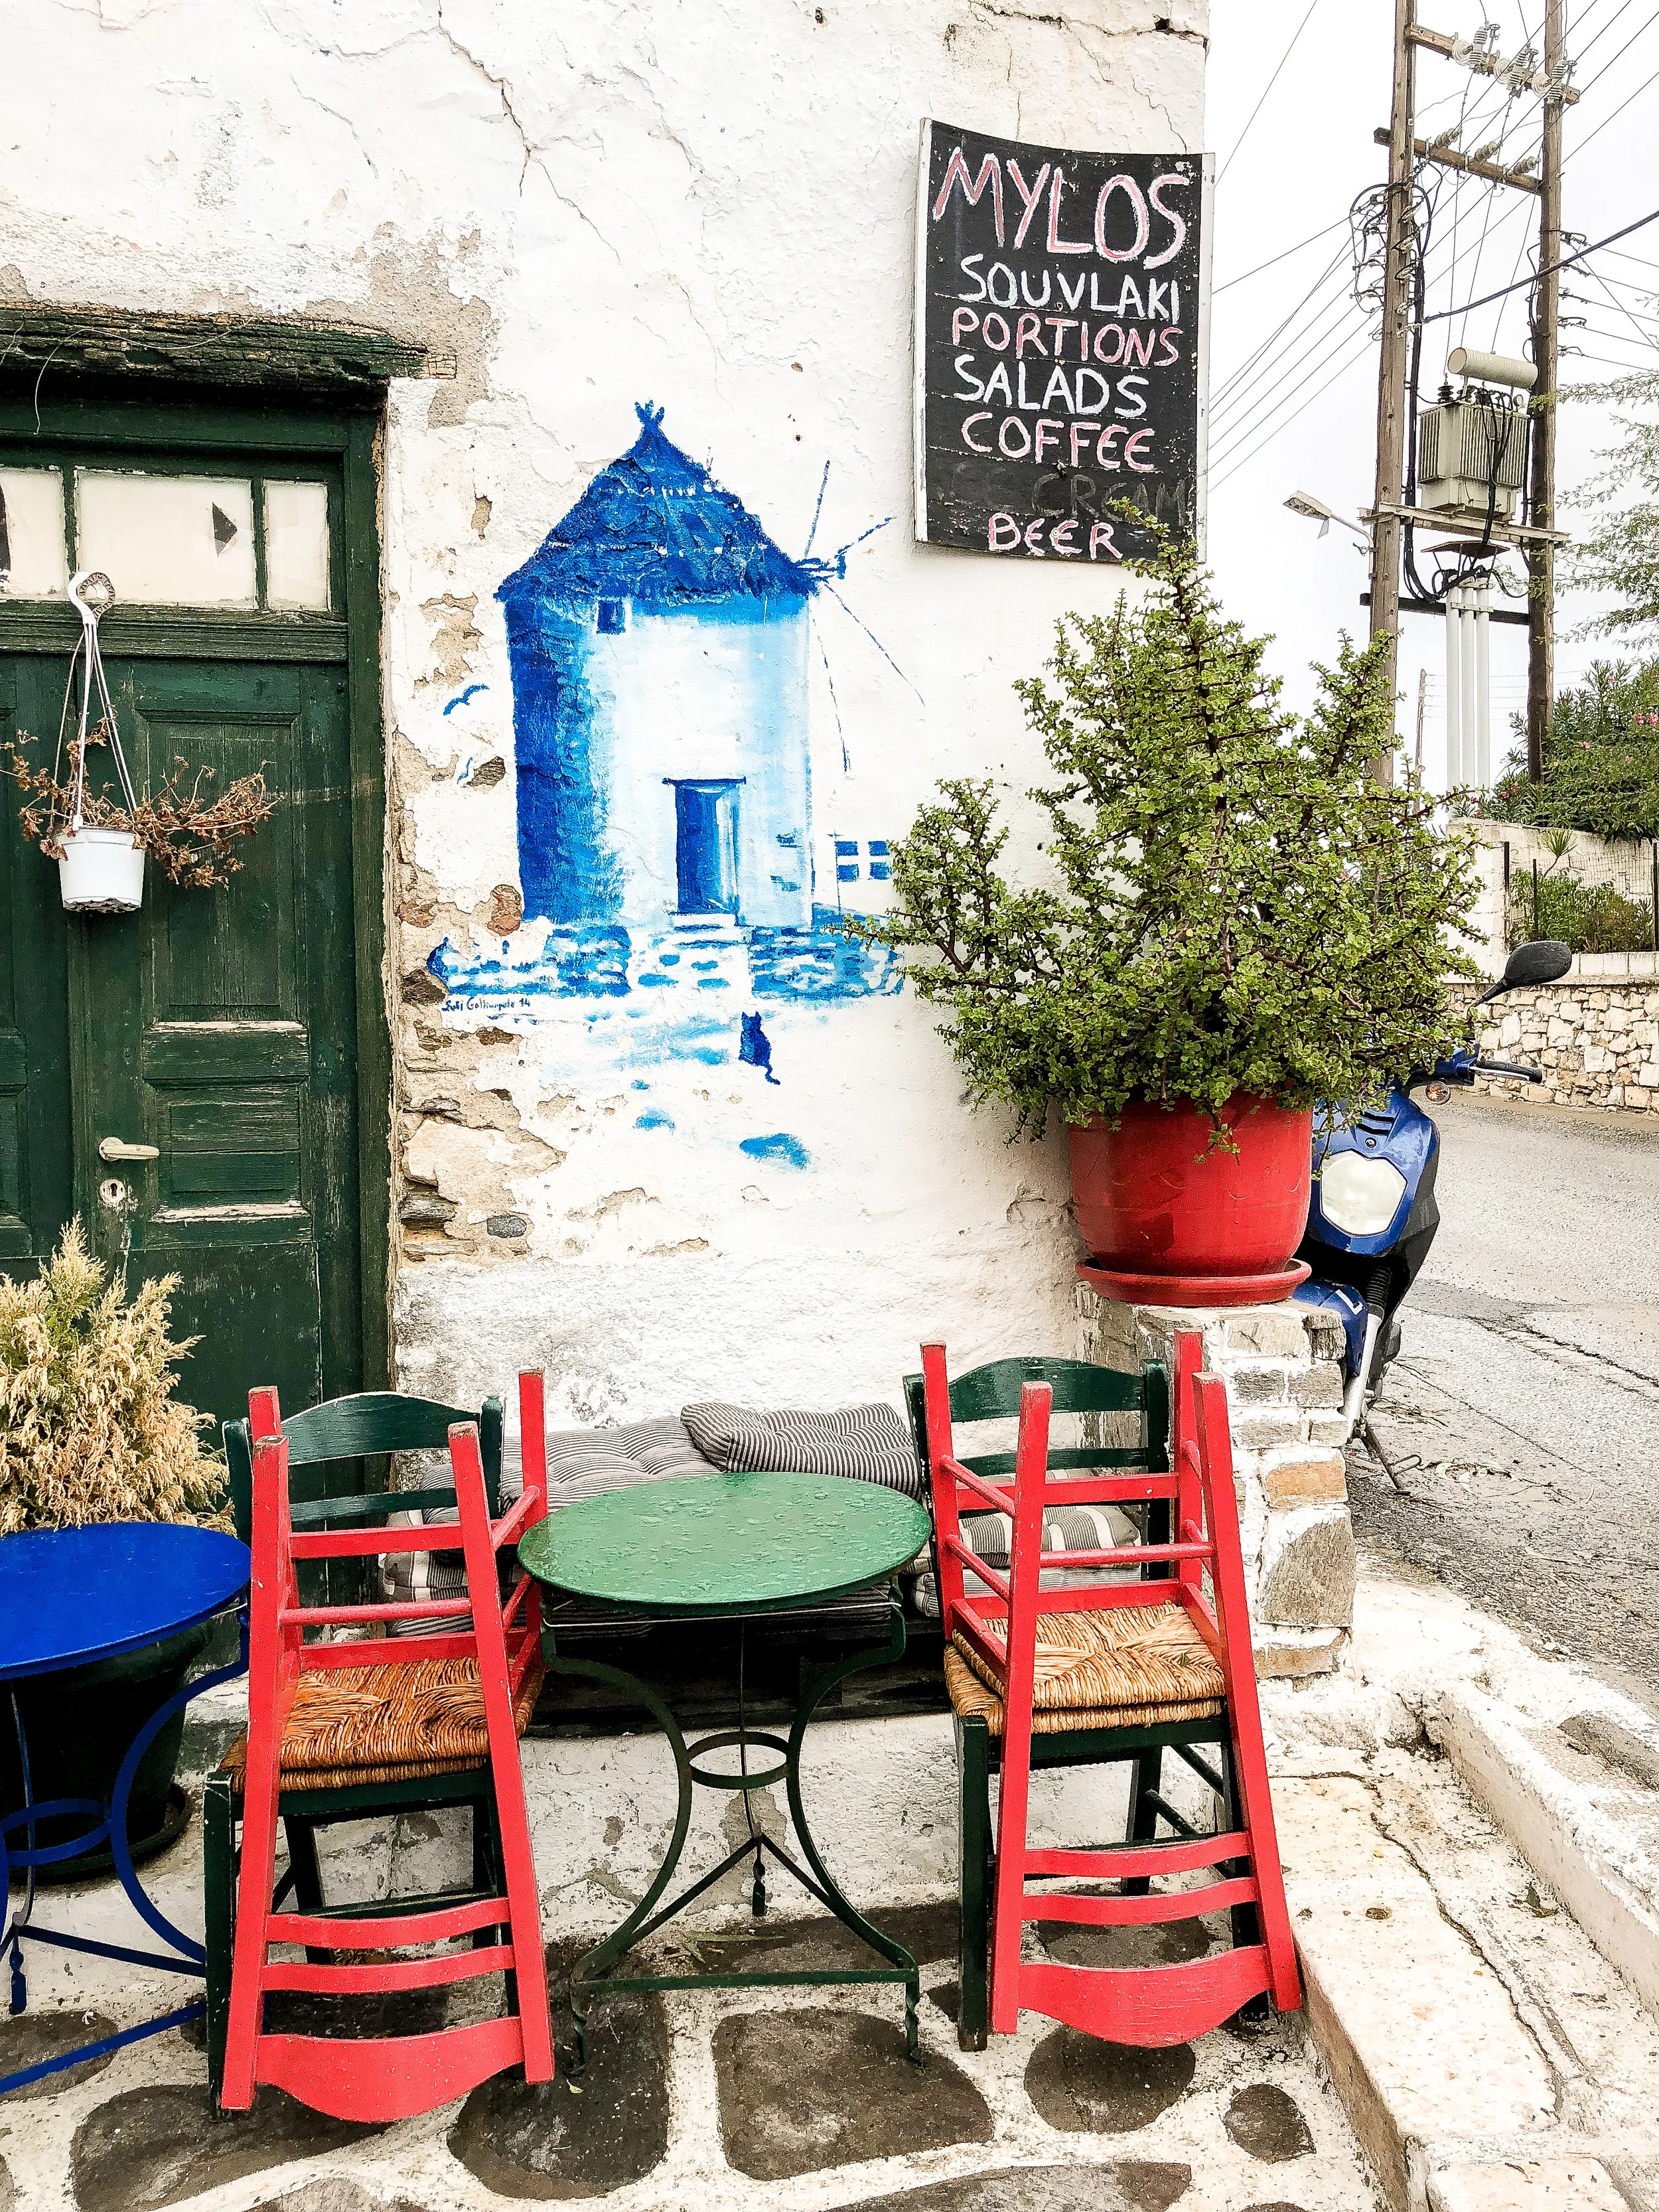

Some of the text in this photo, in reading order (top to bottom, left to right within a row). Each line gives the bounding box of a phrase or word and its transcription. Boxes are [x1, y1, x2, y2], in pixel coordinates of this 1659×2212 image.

[933, 147, 1189, 269] MYLOS
[958, 254, 1180, 325] SOUVLAKI
[952, 307, 1183, 366] PORTIONS
[954, 354, 1149, 417] SALADS
[962, 412, 1155, 471] COFFEE
[987, 512, 1123, 560] BEER
[519, 997, 531, 1007] 14
